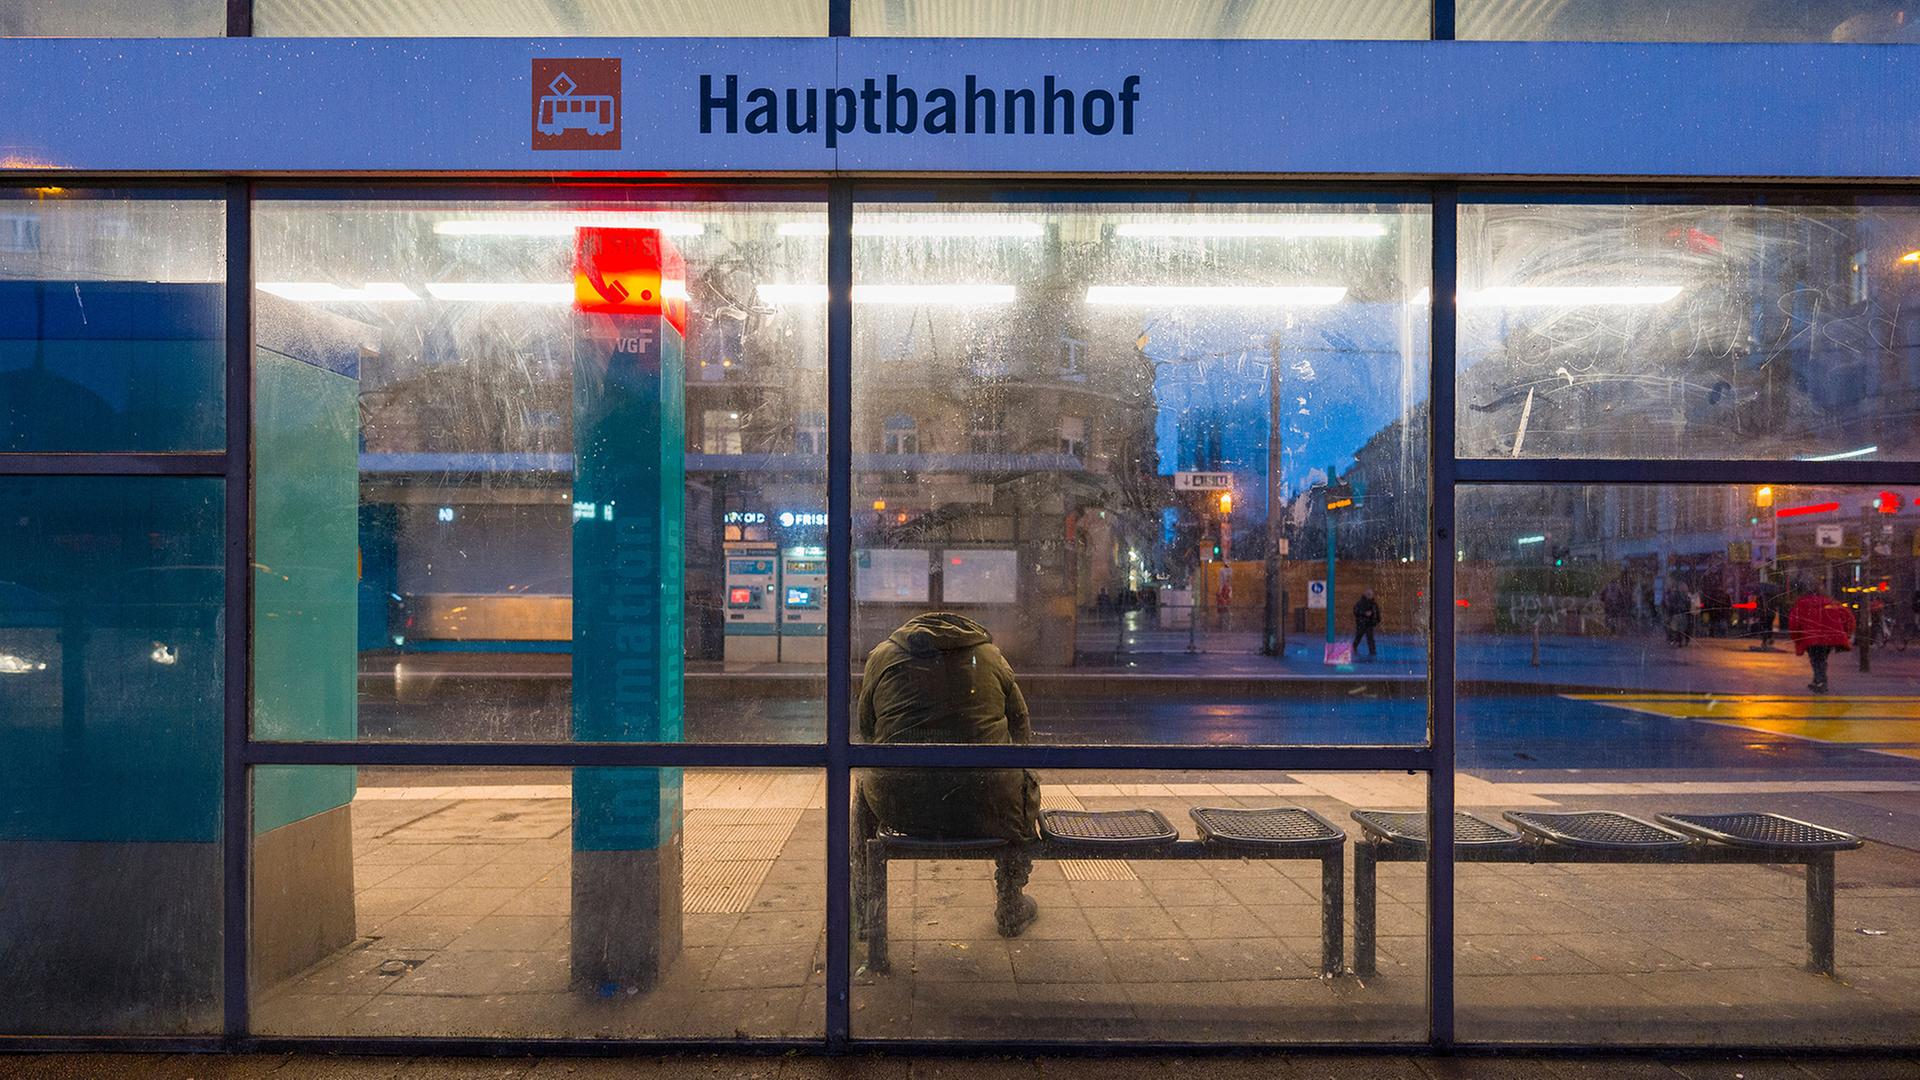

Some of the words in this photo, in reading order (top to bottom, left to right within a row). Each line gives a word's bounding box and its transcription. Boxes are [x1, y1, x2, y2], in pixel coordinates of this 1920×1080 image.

[700, 75, 1141, 148] Hauptbahnhof
[616, 328, 653, 354] VGF
[600, 515, 653, 834] Infrmation
